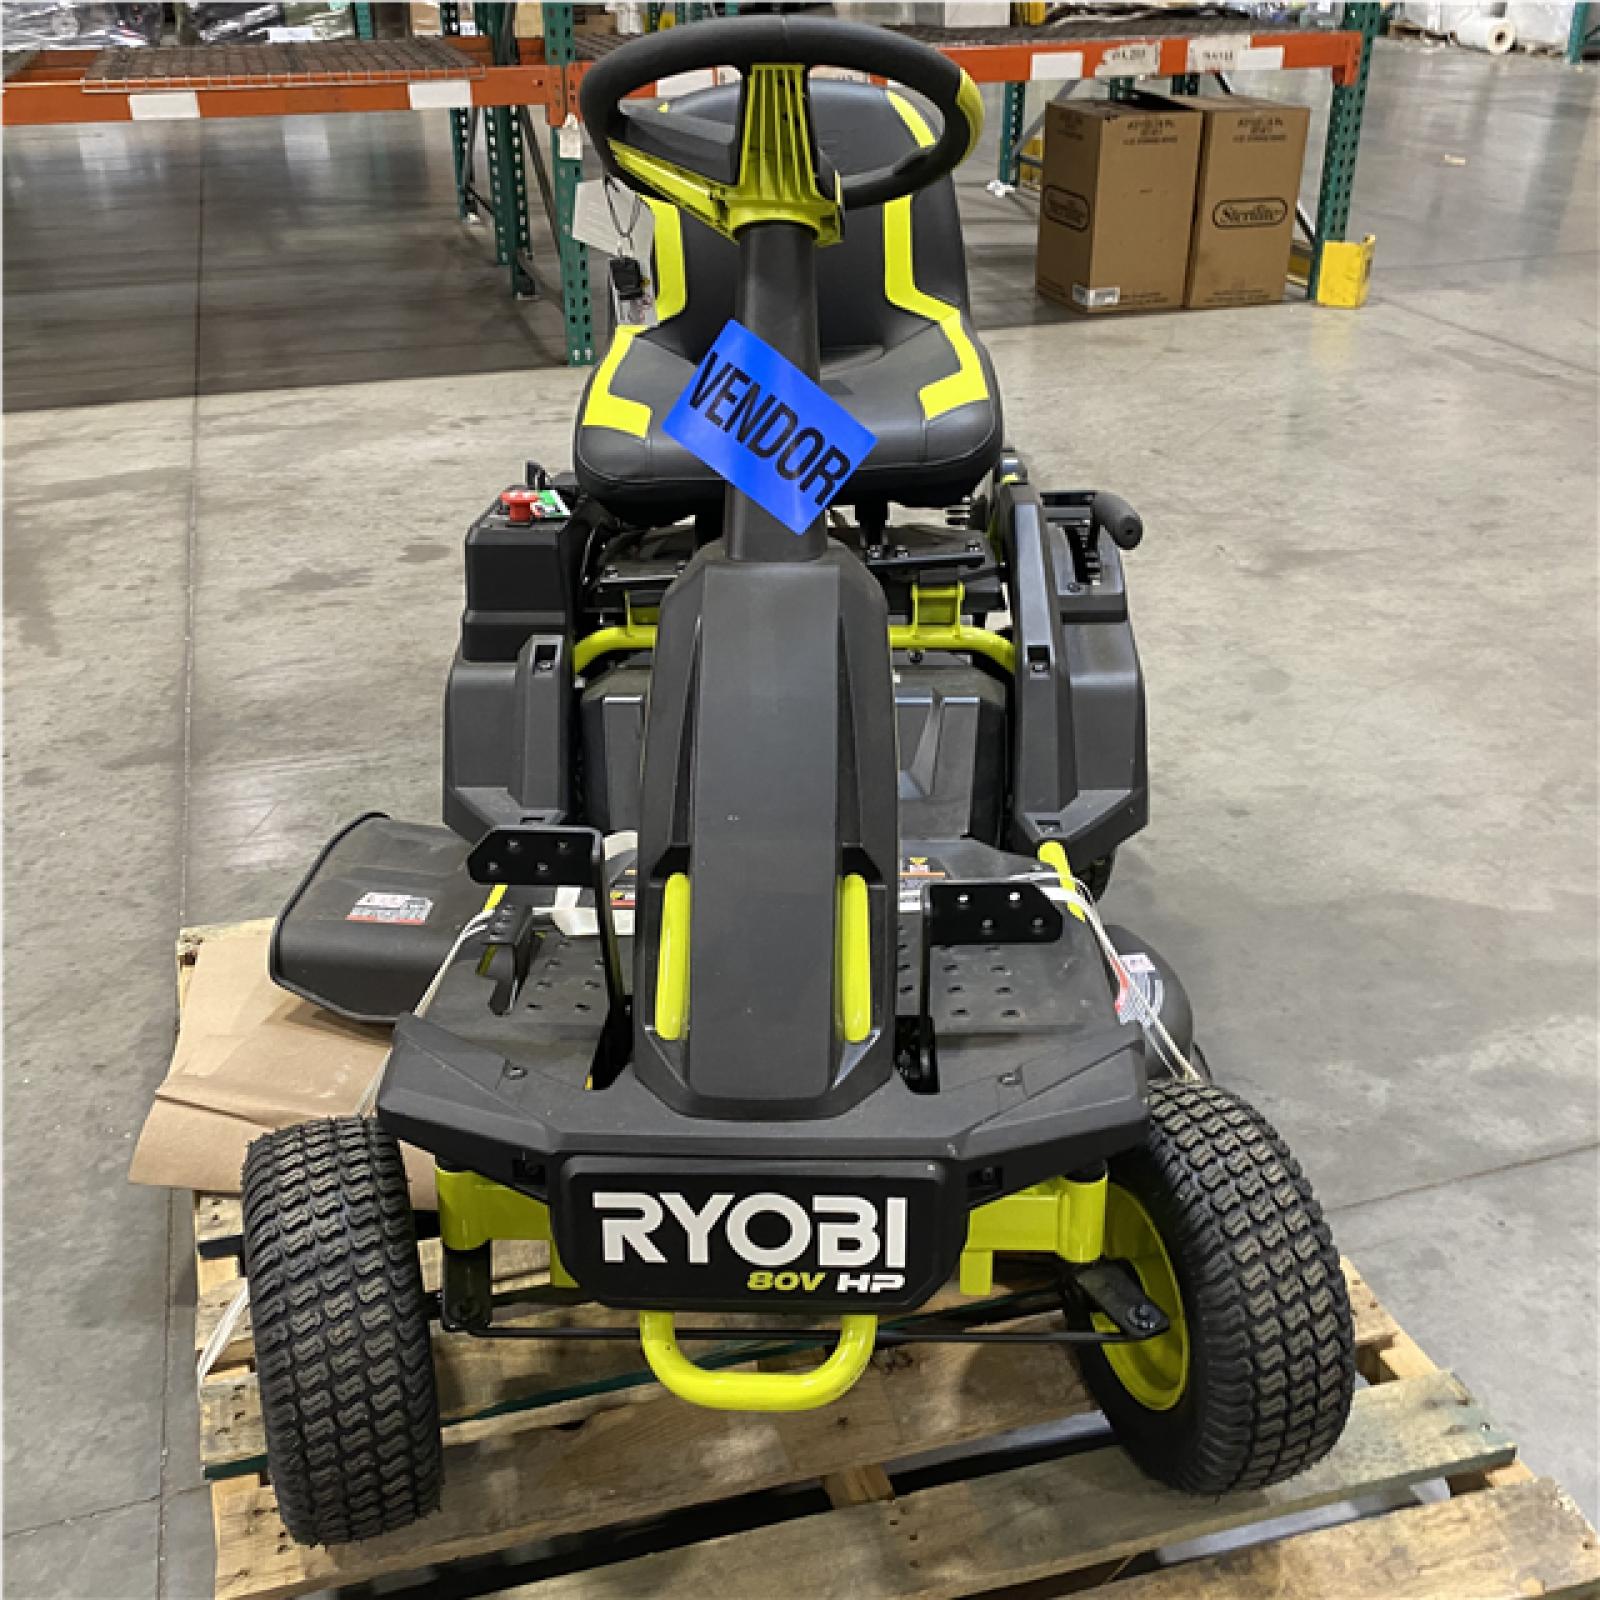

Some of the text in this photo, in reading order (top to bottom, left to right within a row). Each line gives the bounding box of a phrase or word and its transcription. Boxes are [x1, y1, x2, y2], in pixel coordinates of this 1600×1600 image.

[690, 351, 850, 506] VENDOR
[592, 1191, 907, 1268] RYOBI
[747, 1271, 905, 1293] 80V HP
